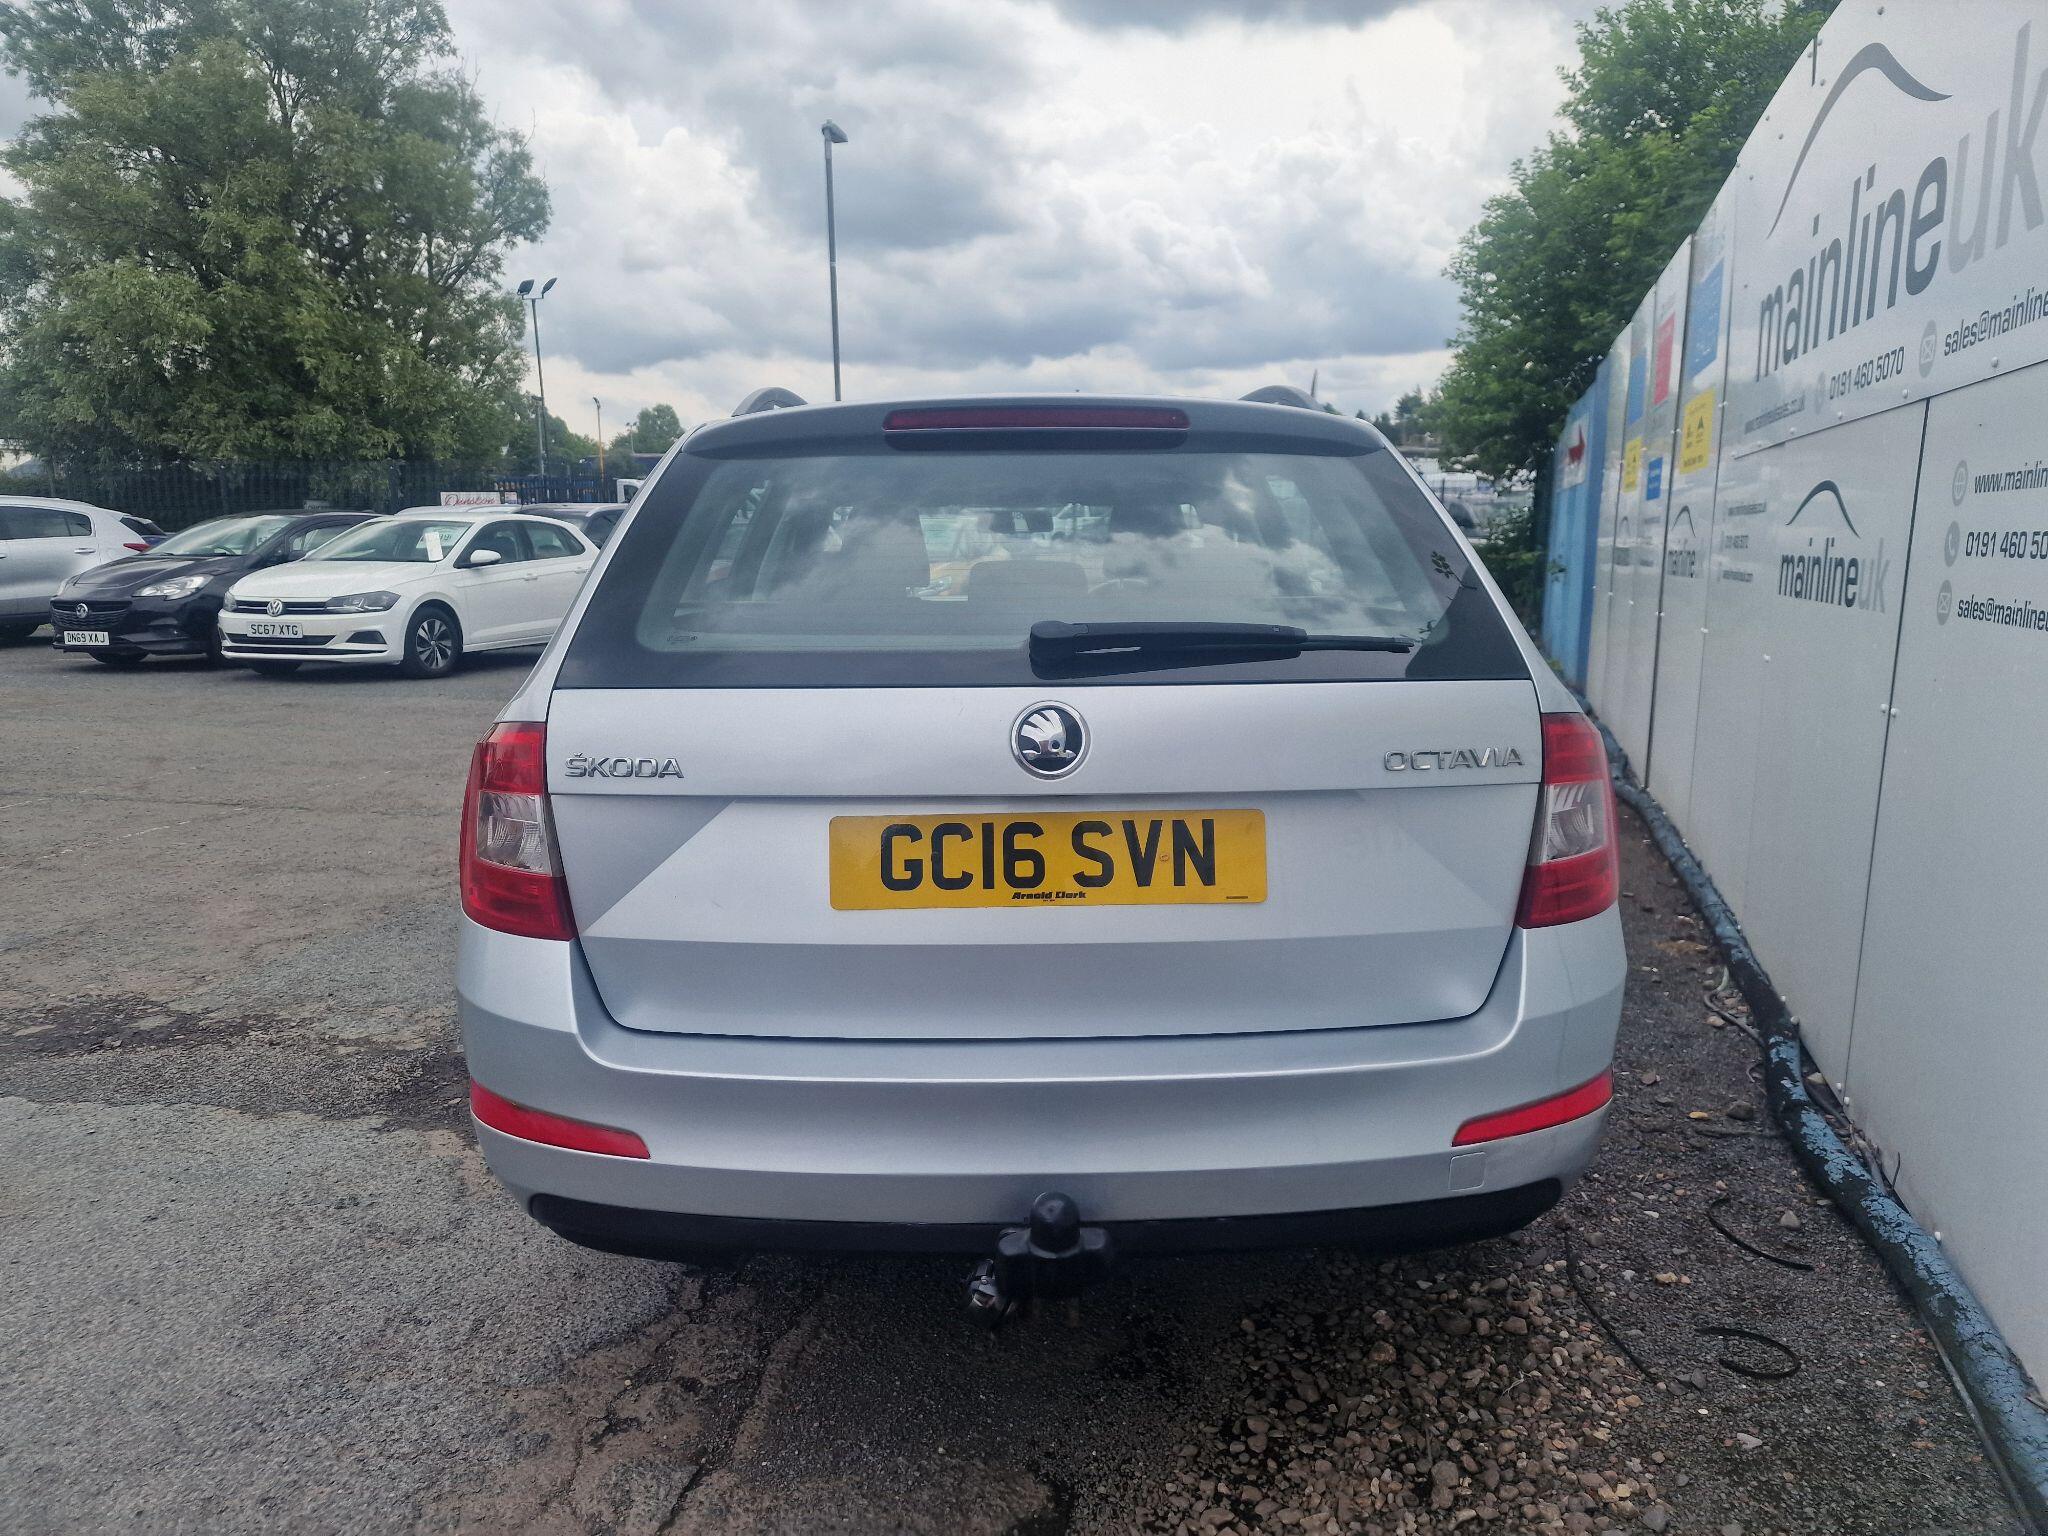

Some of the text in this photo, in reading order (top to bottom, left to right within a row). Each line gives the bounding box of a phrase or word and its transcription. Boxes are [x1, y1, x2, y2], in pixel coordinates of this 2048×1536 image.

[1756, 20, 2048, 382] mainlineuk
[1944, 286, 2048, 357] sales@mainline
[1829, 346, 1905, 400] 0191 460 5070
[1974, 461, 2048, 494] www.mainlin
[1966, 531, 1997, 557] 0191
[1999, 531, 2028, 559] 460
[1778, 537, 1891, 614] mainlineuk
[67, 633, 106, 644] DN69 XAJ
[250, 624, 299, 636] SC67 XTG
[565, 752, 685, 779] ŠKODA
[1384, 747, 1525, 771] OCTAVIA
[880, 819, 1216, 892] GC16 SVN
[1011, 890, 1087, 900] Arnold Clark
